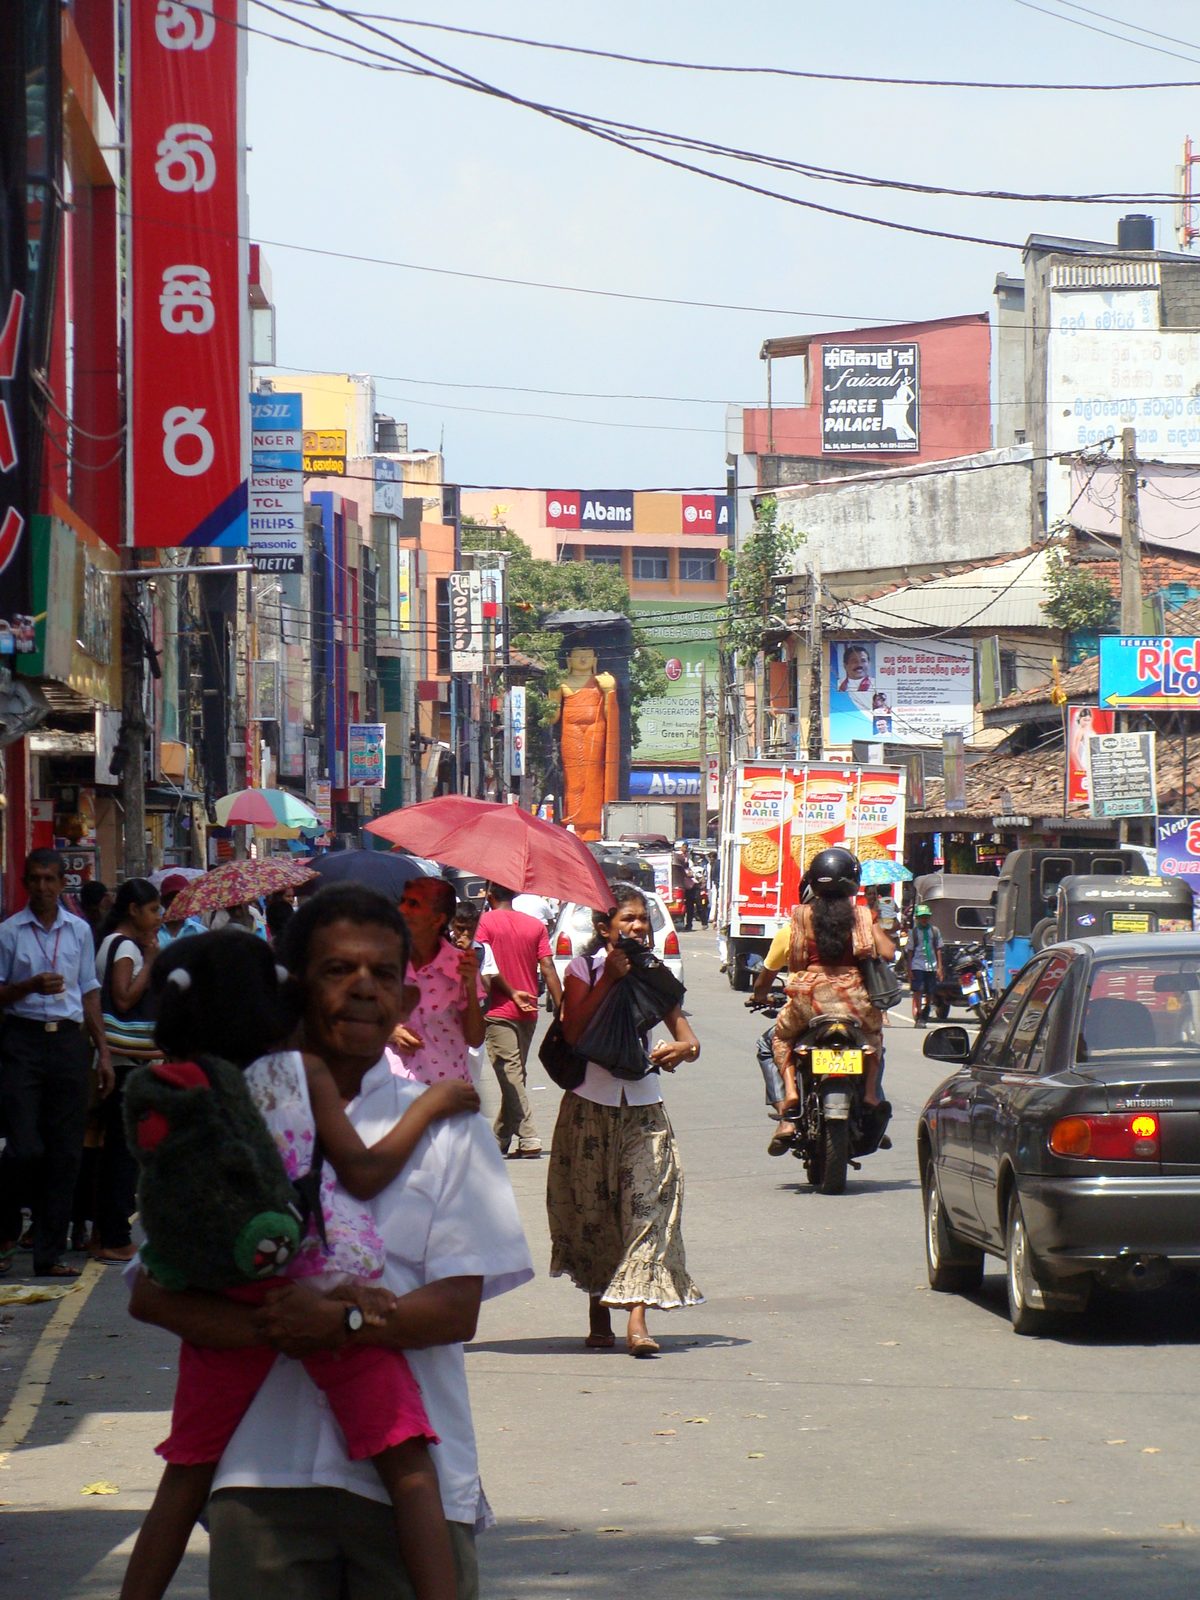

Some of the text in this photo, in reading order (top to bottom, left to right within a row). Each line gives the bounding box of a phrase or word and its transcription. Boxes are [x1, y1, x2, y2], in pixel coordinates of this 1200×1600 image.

[828, 399, 877, 414] SAREE
[825, 417, 882, 432] PALACE
[253, 498, 283, 508] TCL
[563, 504, 577, 515] LG
[582, 501, 632, 522] Abans
[699, 509, 713, 520] LG
[661, 730, 685, 738] Green
[744, 800, 779, 809] GOLD
[742, 809, 780, 817] MARIE
[1158, 817, 1188, 841] New
[1126, 1098, 1174, 1108] MITSUBISHI
